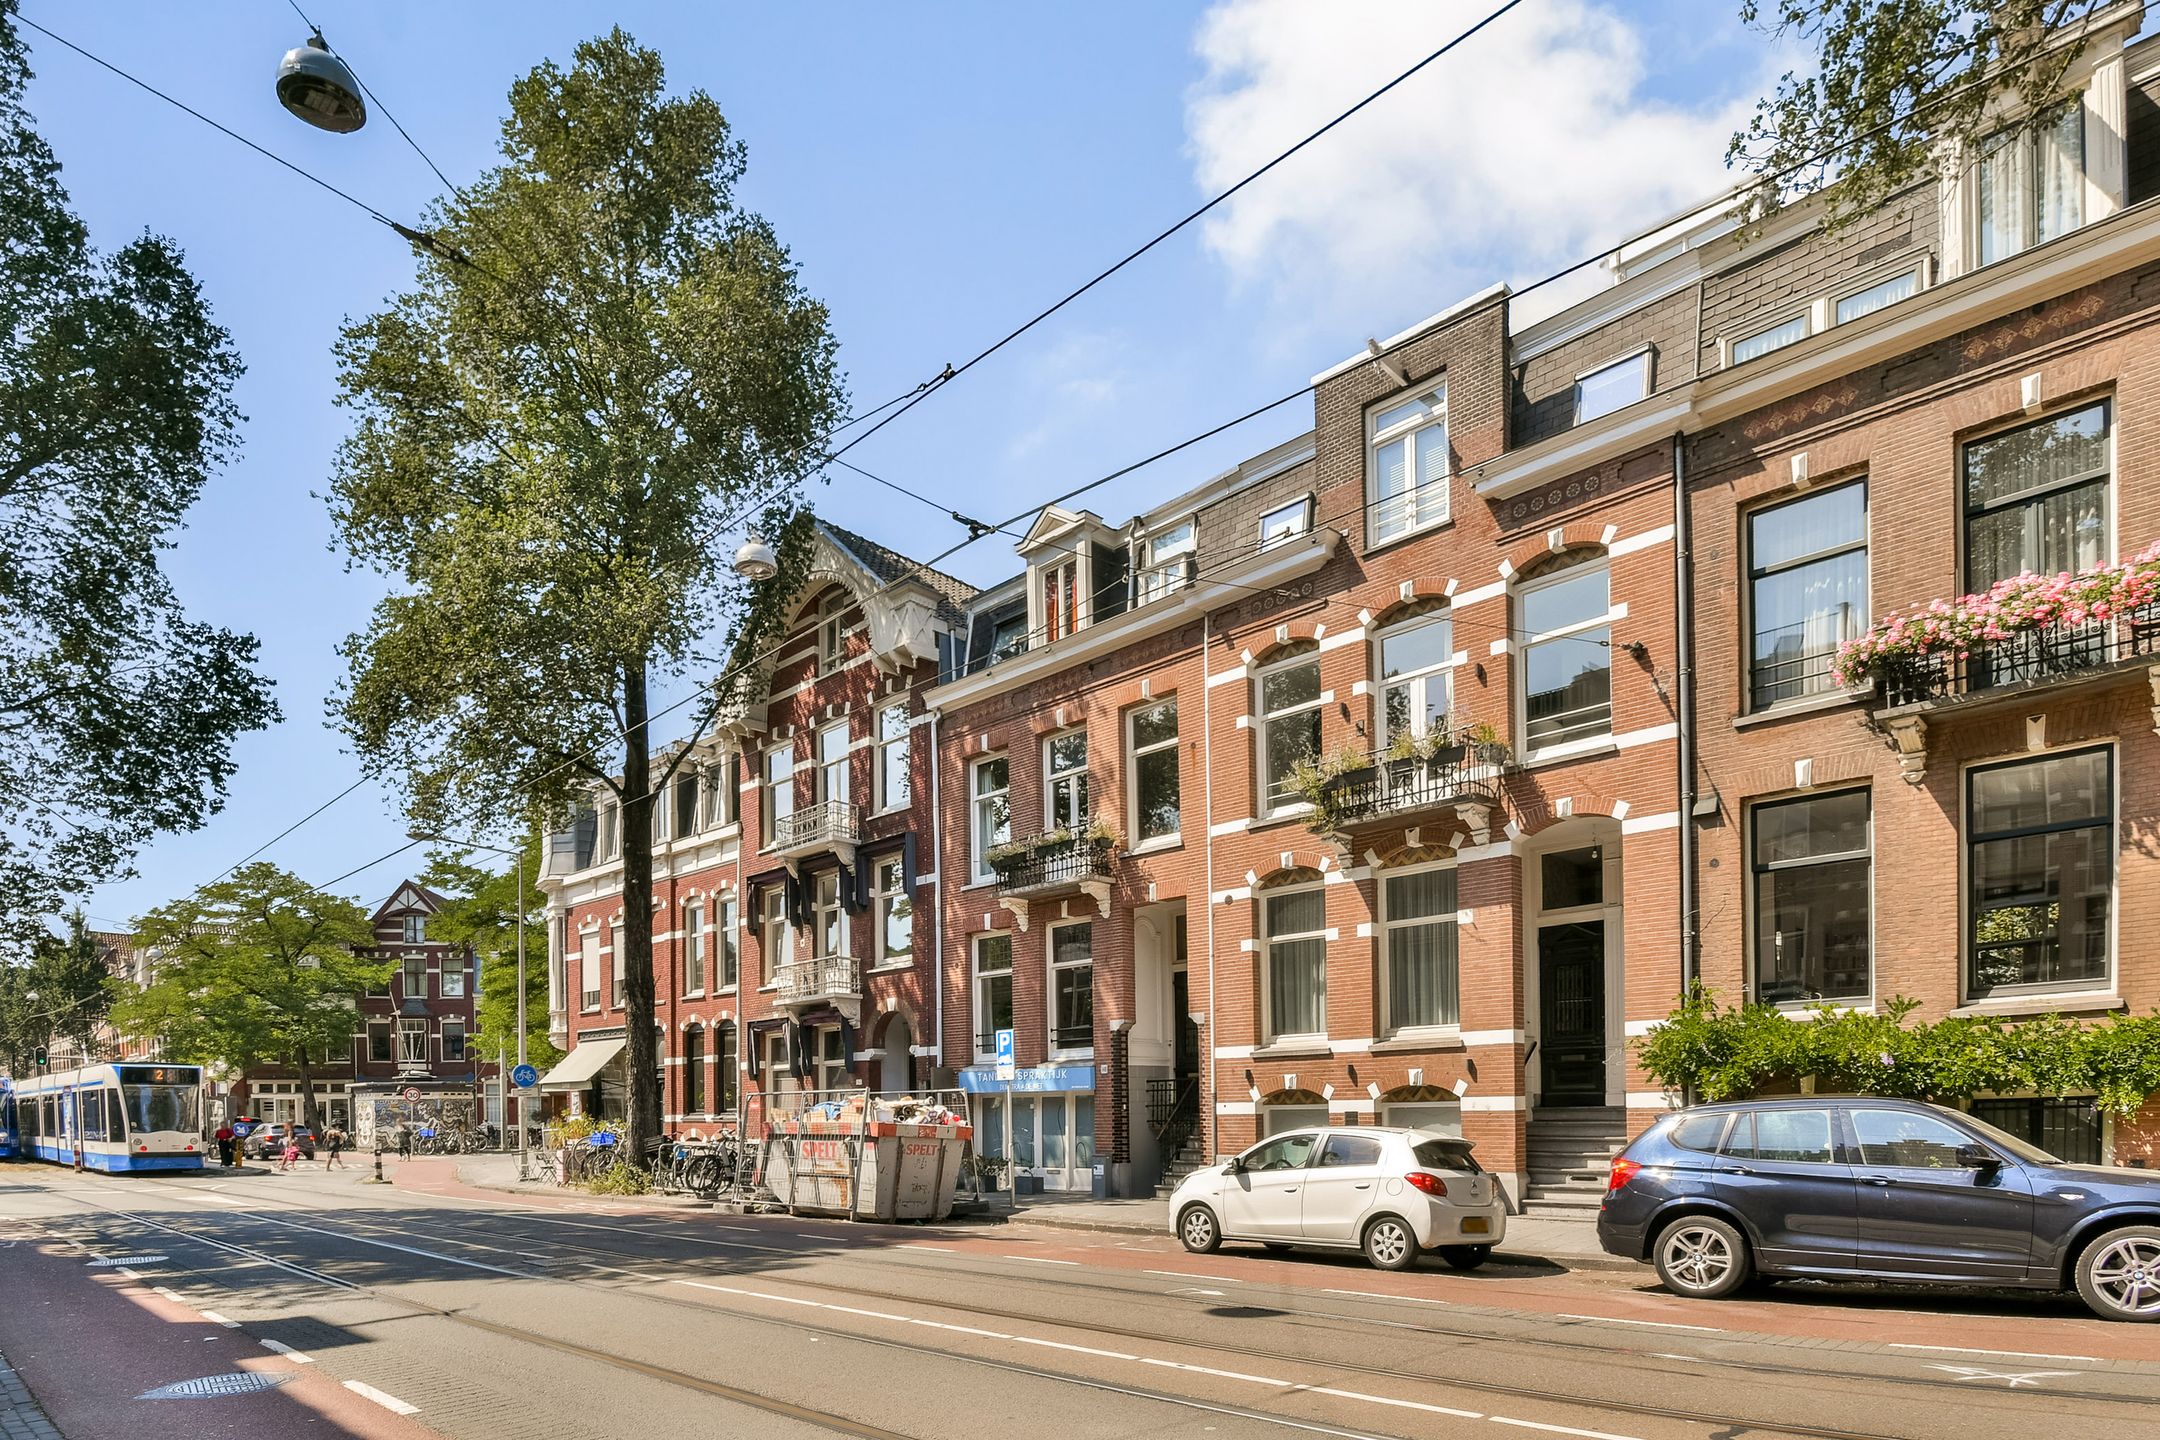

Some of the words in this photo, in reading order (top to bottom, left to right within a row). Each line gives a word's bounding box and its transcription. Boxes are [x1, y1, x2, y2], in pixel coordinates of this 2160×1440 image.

[999, 1033, 1010, 1053] P
[155, 1069, 164, 1080] 2
[977, 1069, 1068, 1082] TANSPRAKTIJK
[802, 1141, 838, 1160] SPELT
[906, 1144, 938, 1156] SPELT
